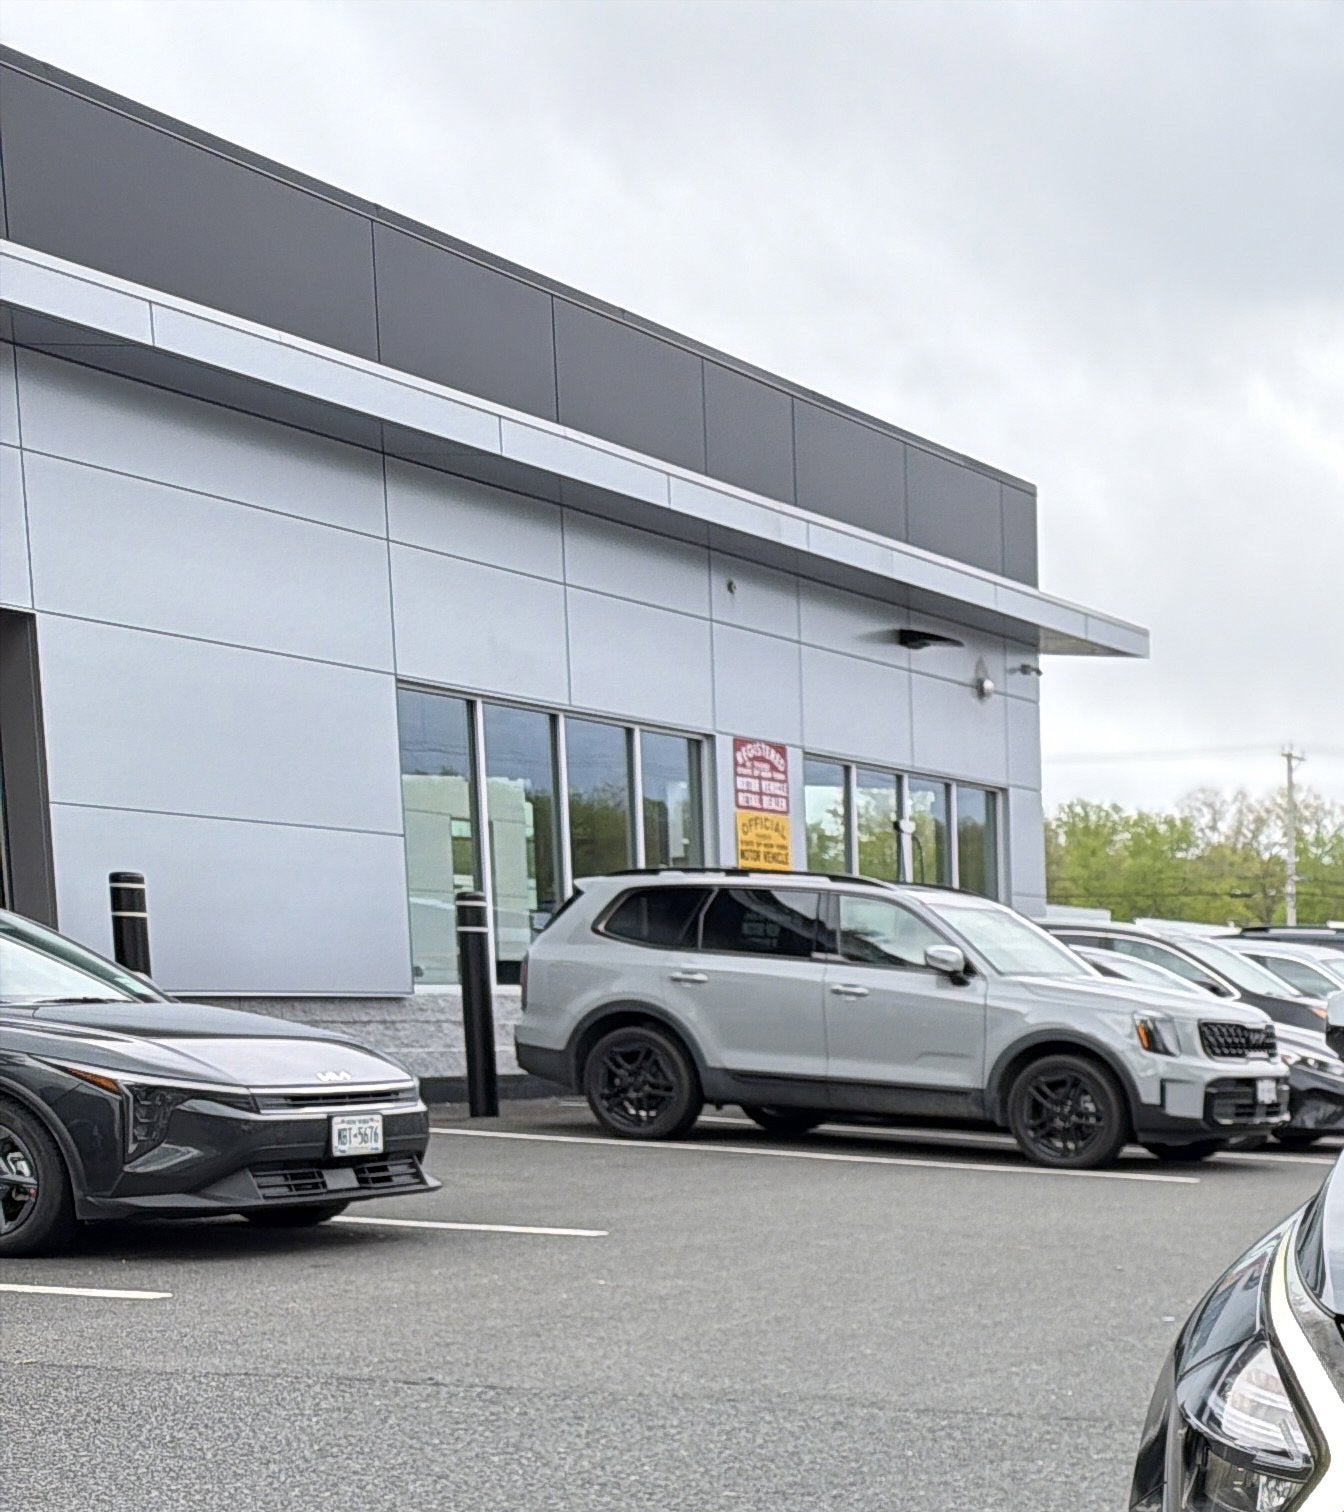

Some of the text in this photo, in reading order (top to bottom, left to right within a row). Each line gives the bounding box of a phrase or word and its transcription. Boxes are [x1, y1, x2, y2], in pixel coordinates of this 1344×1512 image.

[736, 741, 786, 772] REGISTERED
[742, 816, 787, 840] OFFICIAL
[741, 849, 789, 865] MOTOR VEHICLE
